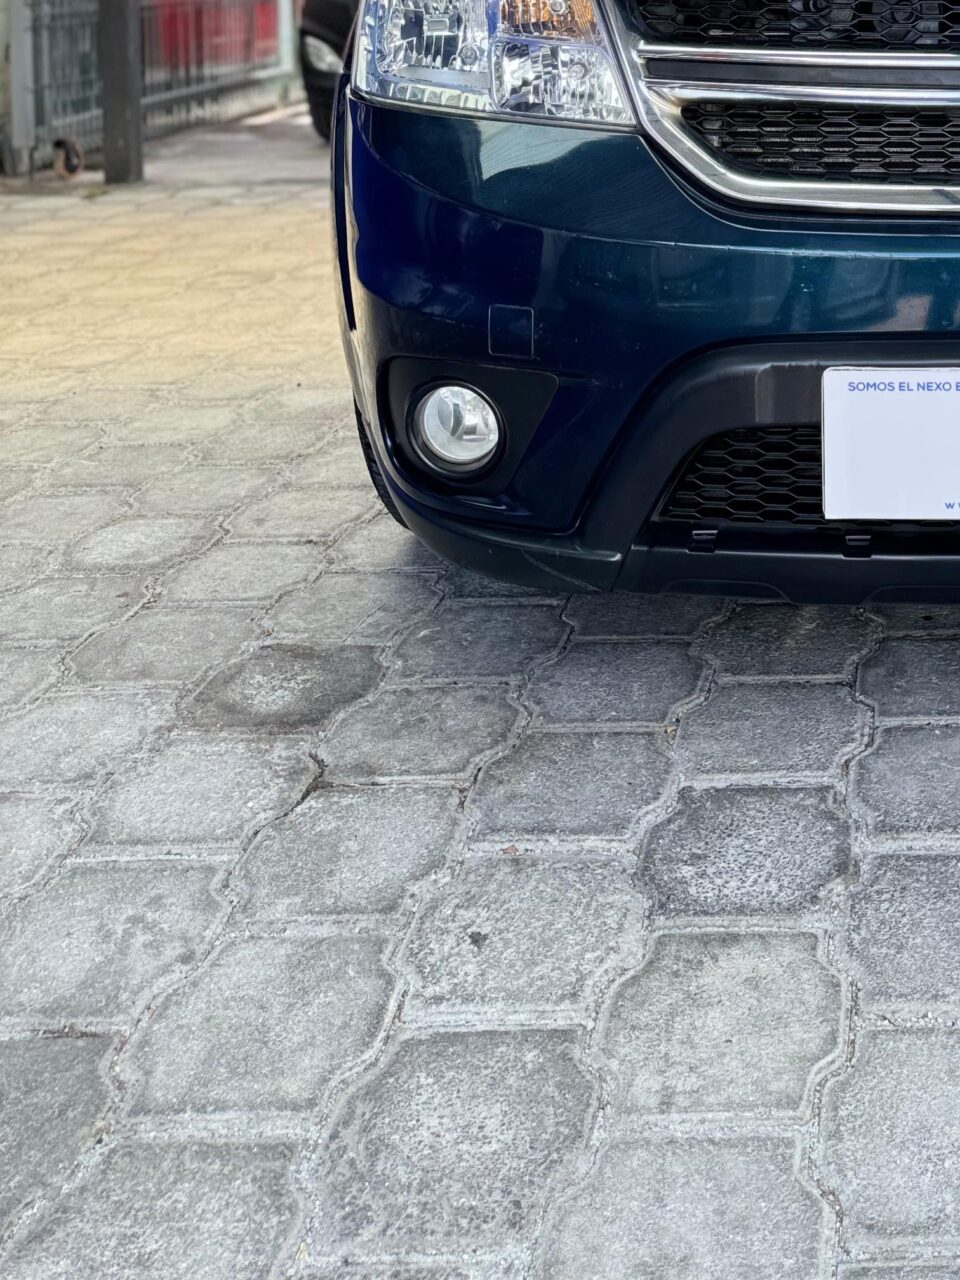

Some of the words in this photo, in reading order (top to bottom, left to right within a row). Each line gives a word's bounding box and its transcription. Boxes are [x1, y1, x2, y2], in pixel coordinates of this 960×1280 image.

[848, 381, 895, 391] SOMOS
[899, 381, 914, 391] EL
[916, 381, 952, 391] NEXO
